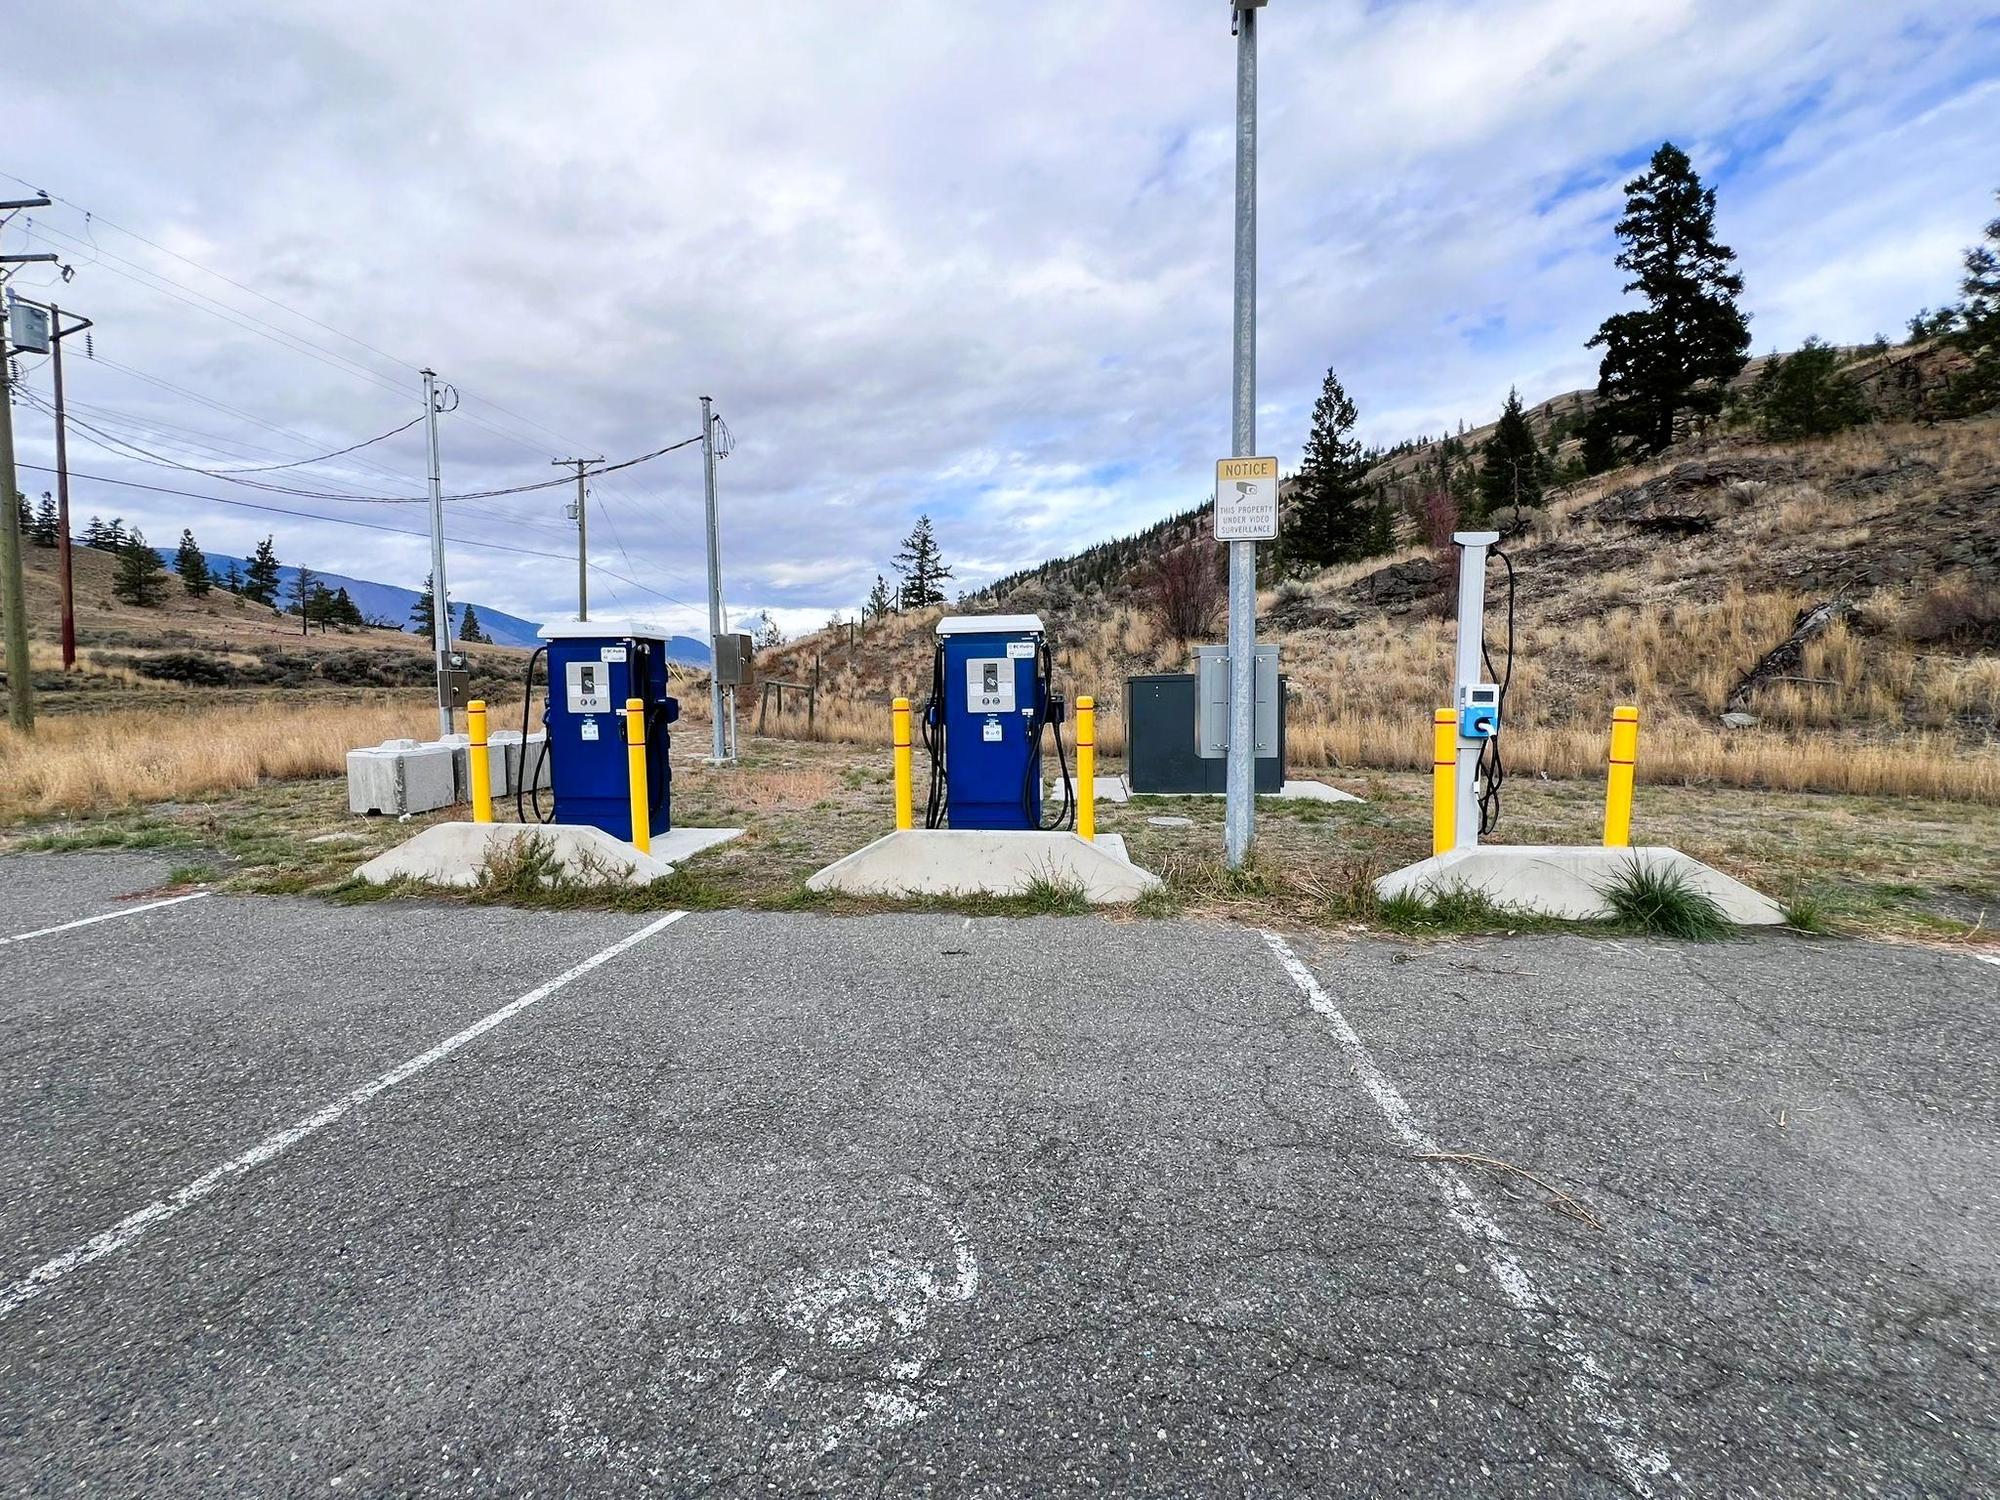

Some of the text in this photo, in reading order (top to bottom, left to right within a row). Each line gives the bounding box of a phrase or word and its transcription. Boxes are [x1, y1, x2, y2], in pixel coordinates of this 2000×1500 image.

[1226, 463, 1268, 476] NOTICE
[1238, 505, 1273, 514] PROPERTY
[1250, 515, 1269, 523] VIDEO
[1221, 525, 1271, 534] SURVEILLANCE
